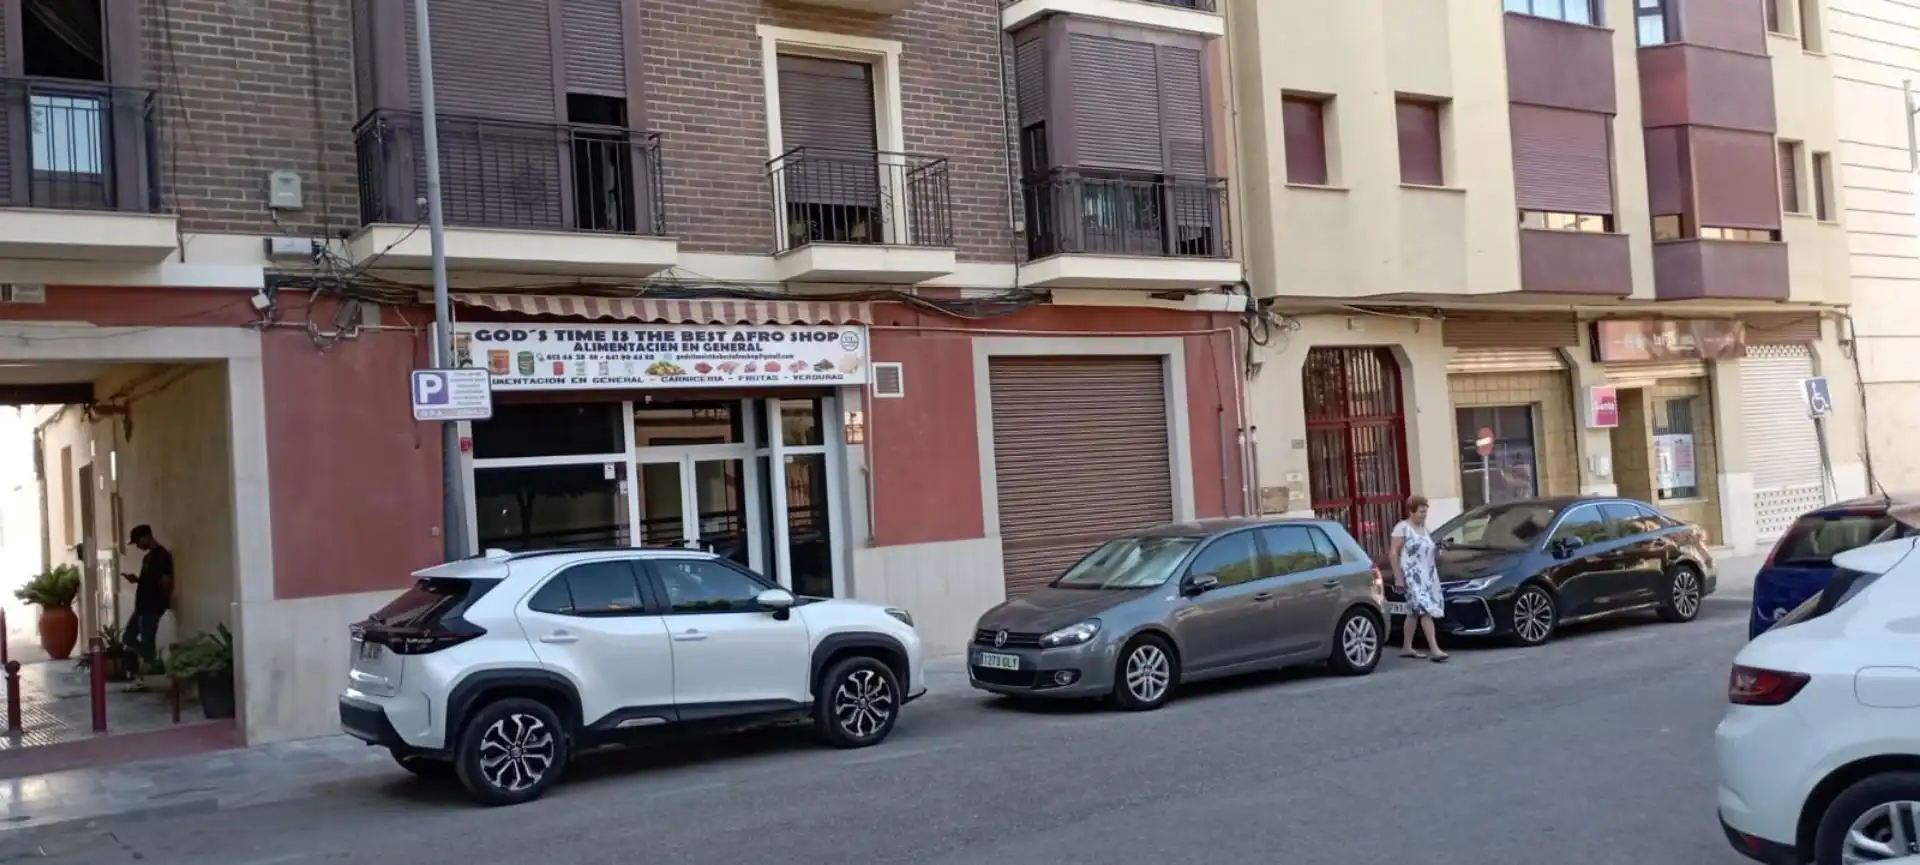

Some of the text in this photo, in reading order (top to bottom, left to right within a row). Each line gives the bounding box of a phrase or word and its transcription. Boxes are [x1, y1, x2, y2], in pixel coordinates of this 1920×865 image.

[554, 329, 606, 342] TIME
[612, 330, 629, 342] IS
[635, 330, 675, 342] THE
[681, 331, 726, 342] BEST
[731, 331, 785, 342] AFRO
[790, 331, 839, 342] SHOP
[573, 342, 763, 352] ALIMENTACIEN EN GENERAL
[492, 377, 565, 385] IMENTACION
[419, 373, 442, 403] P
